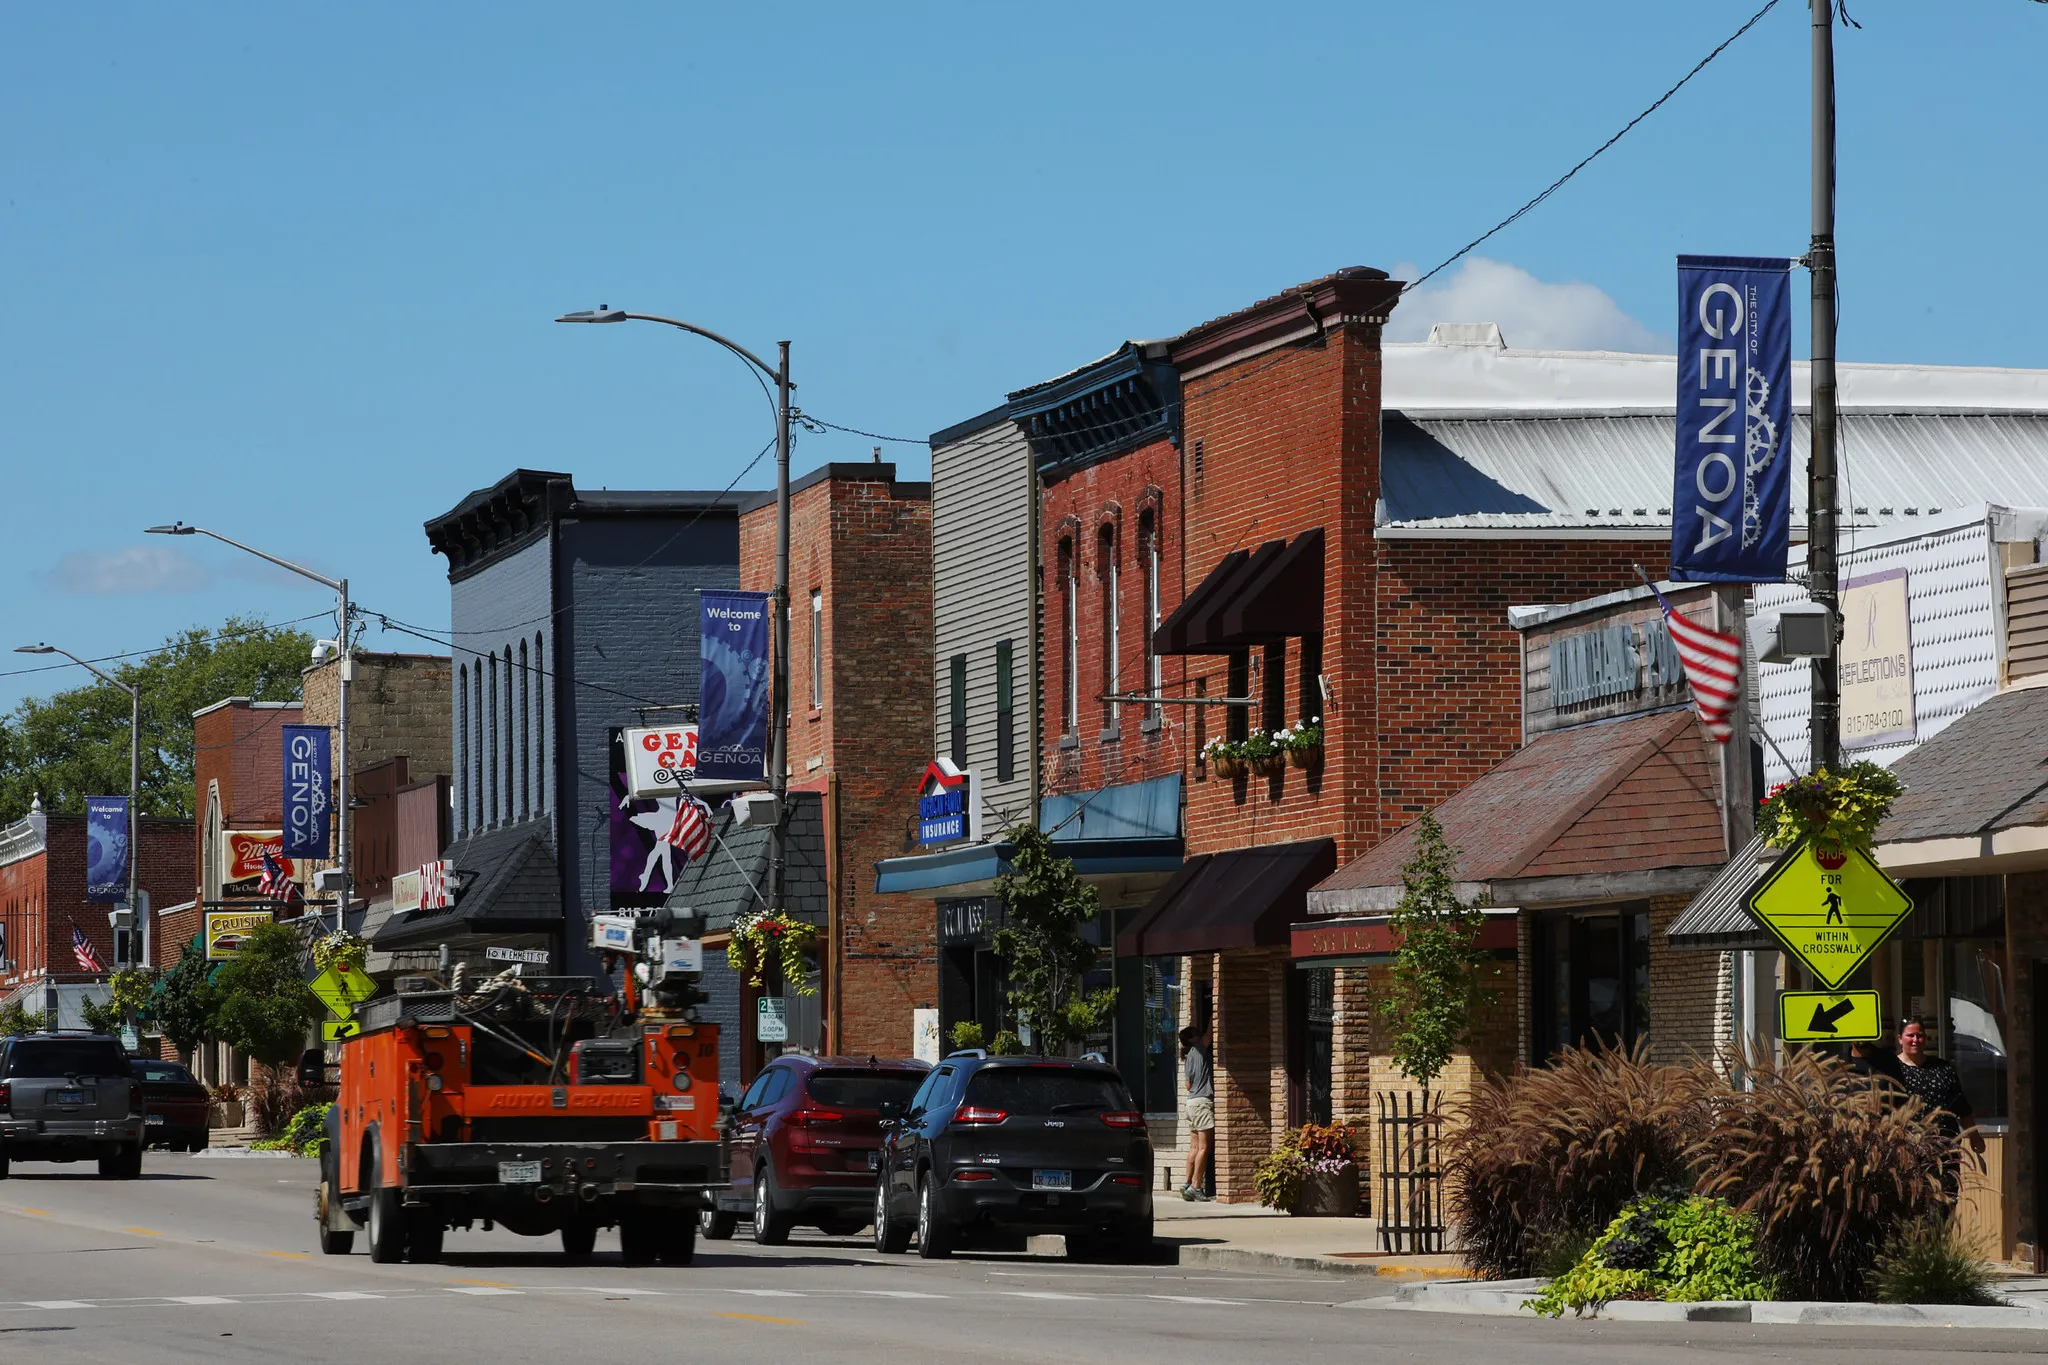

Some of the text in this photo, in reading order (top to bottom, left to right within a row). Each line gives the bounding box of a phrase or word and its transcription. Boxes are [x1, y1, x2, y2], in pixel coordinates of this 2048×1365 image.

[1750, 340, 1758, 356] OF
[1694, 283, 1744, 554] GENOA
[707, 608, 762, 620] Welcome
[728, 621, 741, 632] to
[642, 732, 698, 751] GEN
[658, 750, 697, 769] CA
[698, 751, 762, 764] GENOA
[292, 736, 311, 848] GENOA
[922, 820, 959, 839] INSURANCE
[419, 860, 446, 910] DANCE
[1821, 874, 1842, 884] FOR
[88, 886, 125, 894] GENOA
[211, 915, 268, 931] CRUISIN'
[944, 904, 982, 936] COMASS
[1816, 932, 1849, 941] WITHIN
[1803, 944, 1862, 954] CROSSWALK
[509, 951, 533, 961] EMMETT
[536, 953, 544, 962] ST
[761, 1001, 766, 1010] 2
[490, 1094, 546, 1108] AUTO
[570, 1094, 641, 1108] CRANE
